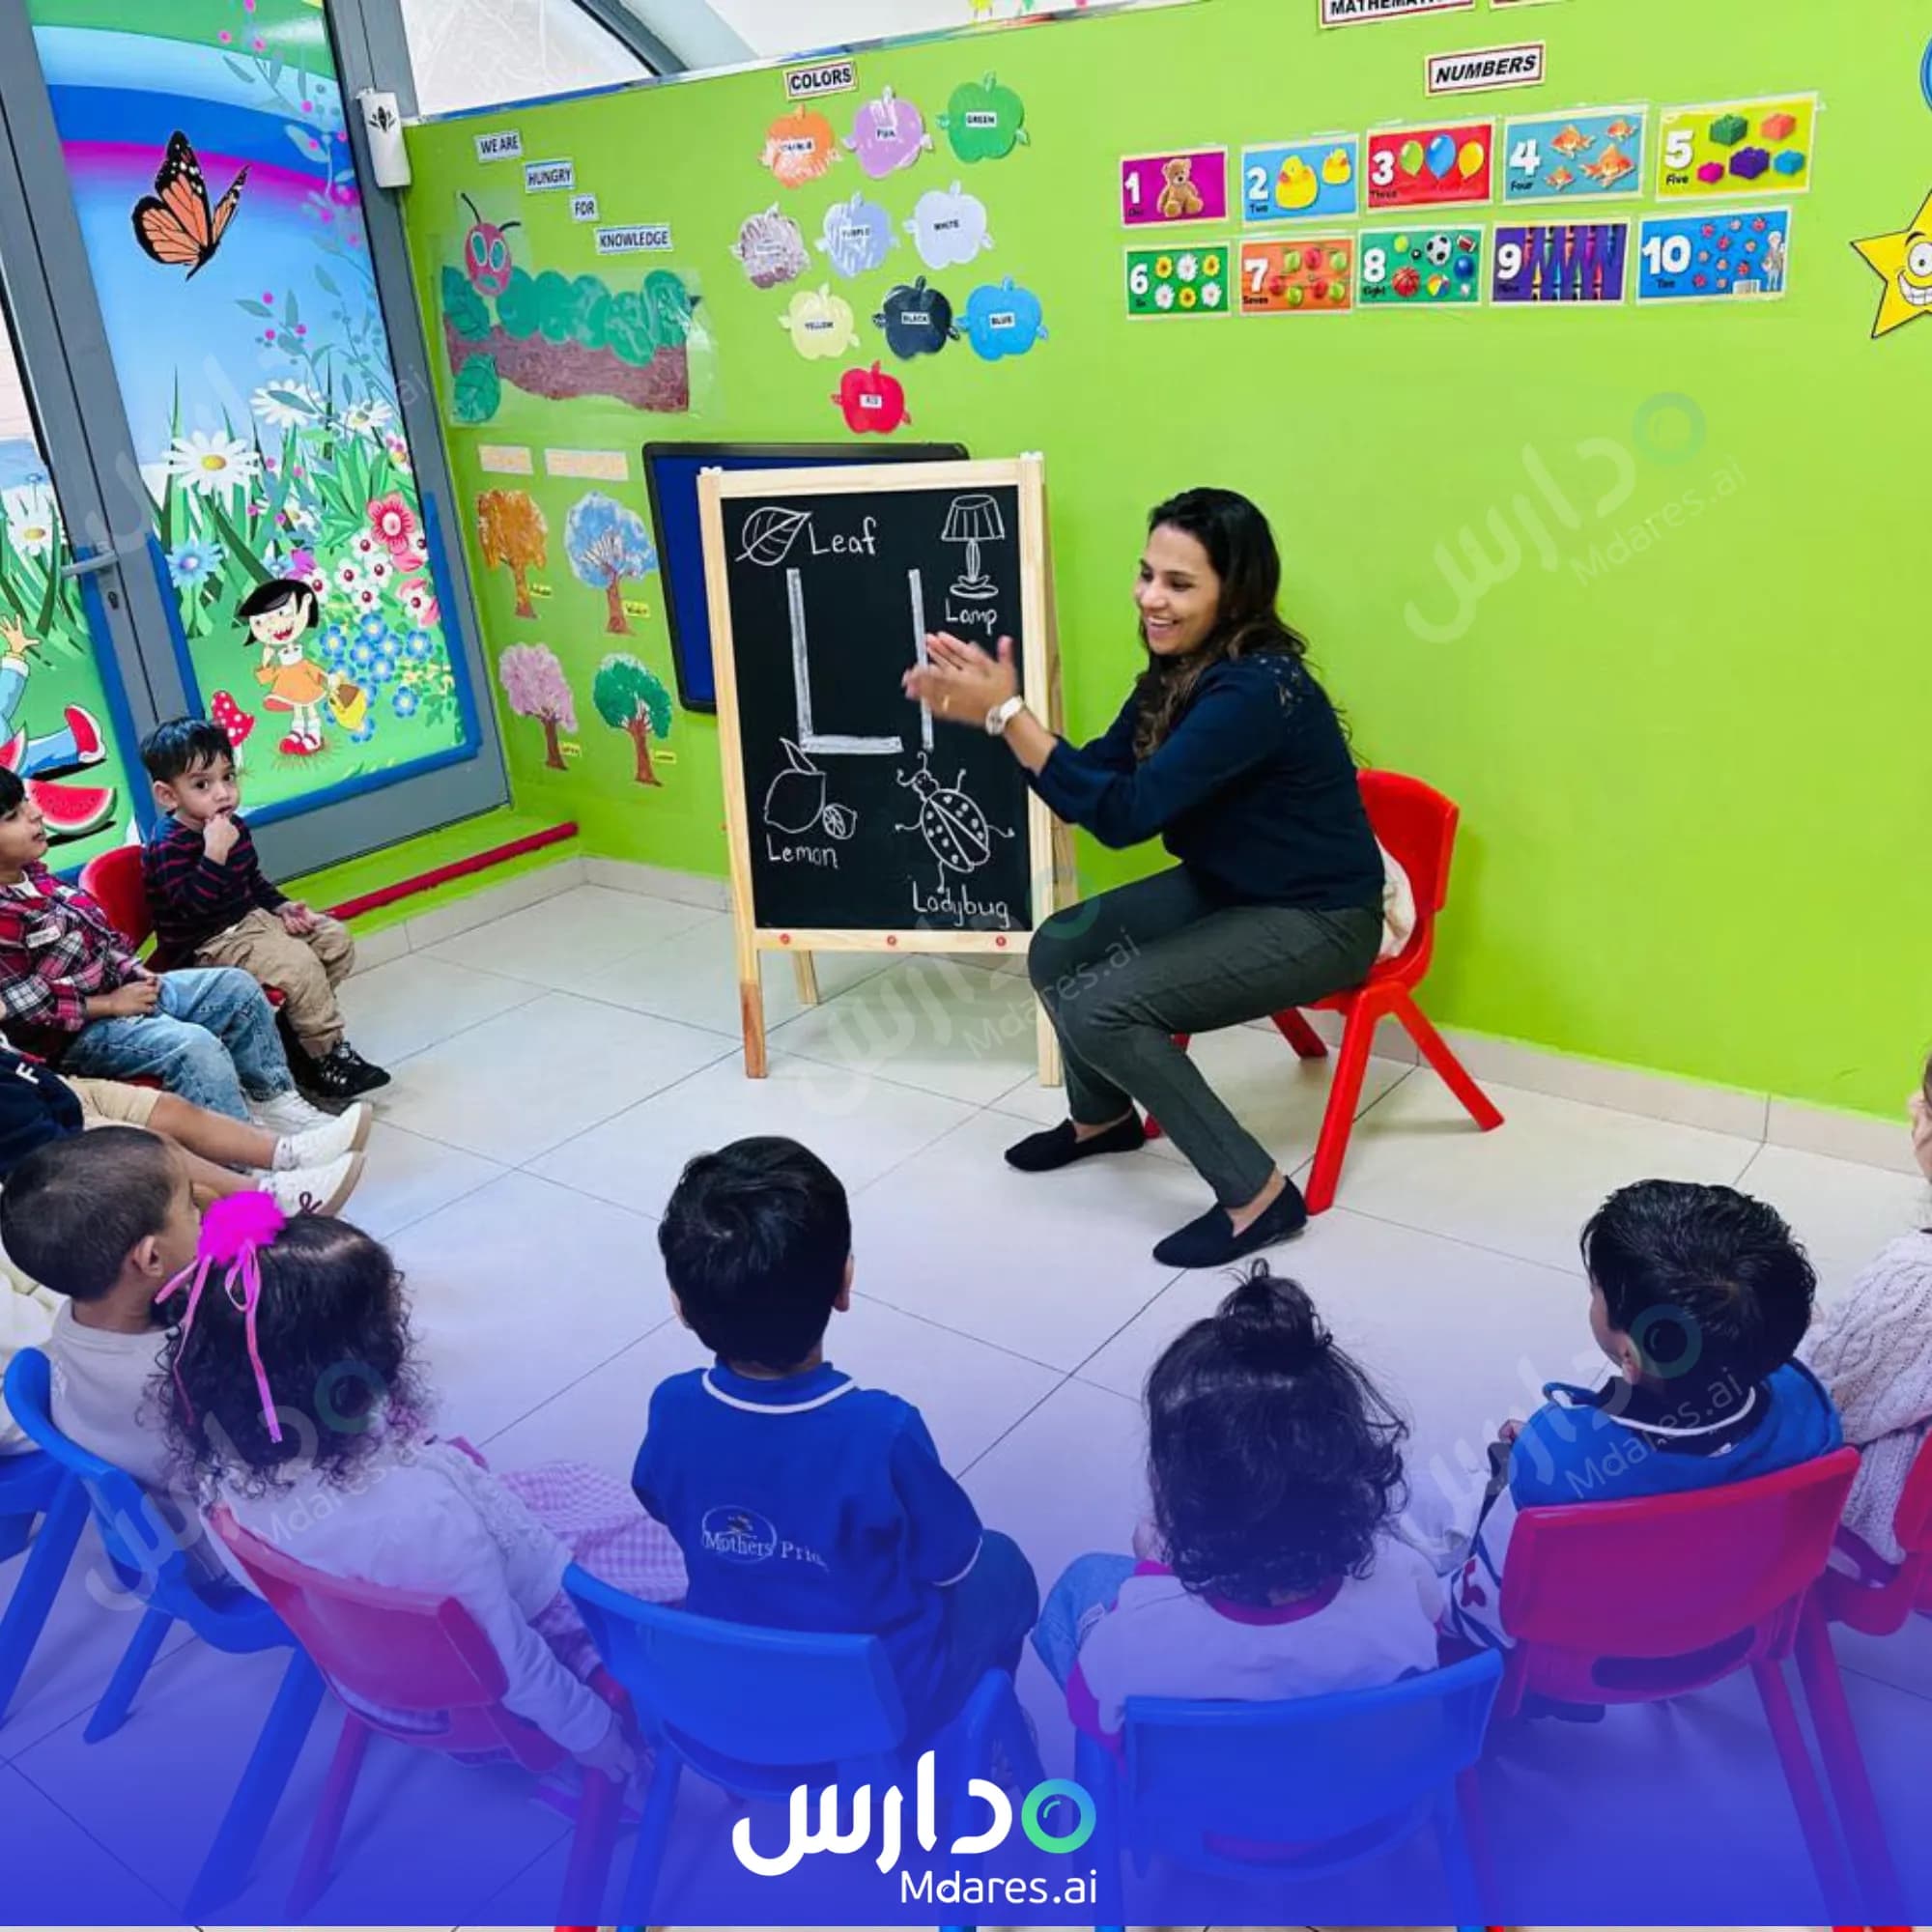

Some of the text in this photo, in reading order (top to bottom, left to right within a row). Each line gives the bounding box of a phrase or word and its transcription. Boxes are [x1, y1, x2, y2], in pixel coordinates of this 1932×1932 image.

[790, 67, 852, 90] COLORS
[1435, 54, 1537, 84] NUMBERS
[967, 115, 995, 126] GREEN
[481, 135, 519, 154] WE ARE
[1509, 139, 1542, 177] 4
[1664, 129, 1694, 171] 5
[528, 168, 572, 186] HUNGRY
[1247, 166, 1269, 201] 2
[1372, 151, 1395, 186] 3
[1665, 174, 1690, 186] Five
[1124, 172, 1141, 205] 1
[1511, 181, 1534, 191] Four
[575, 201, 595, 216] FOR
[600, 231, 668, 247] KNOWLEDGE
[934, 219, 959, 231] WHITE
[1363, 247, 1386, 283] 8
[1497, 242, 1522, 280] 9
[1642, 235, 1691, 275] 10
[1130, 263, 1149, 295] 6
[1243, 258, 1268, 293] 7
[1242, 295, 1268, 304] Seven
[805, 320, 835, 330] YELLOW
[903, 314, 928, 324] BLACK
[991, 315, 1013, 327] BLUE
[809, 516, 878, 555] Leaf
[945, 598, 998, 636] Lamp
[766, 833, 839, 869] Lemon
[913, 881, 1010, 930] Ladybug
[702, 1530, 774, 1558] Mothers
